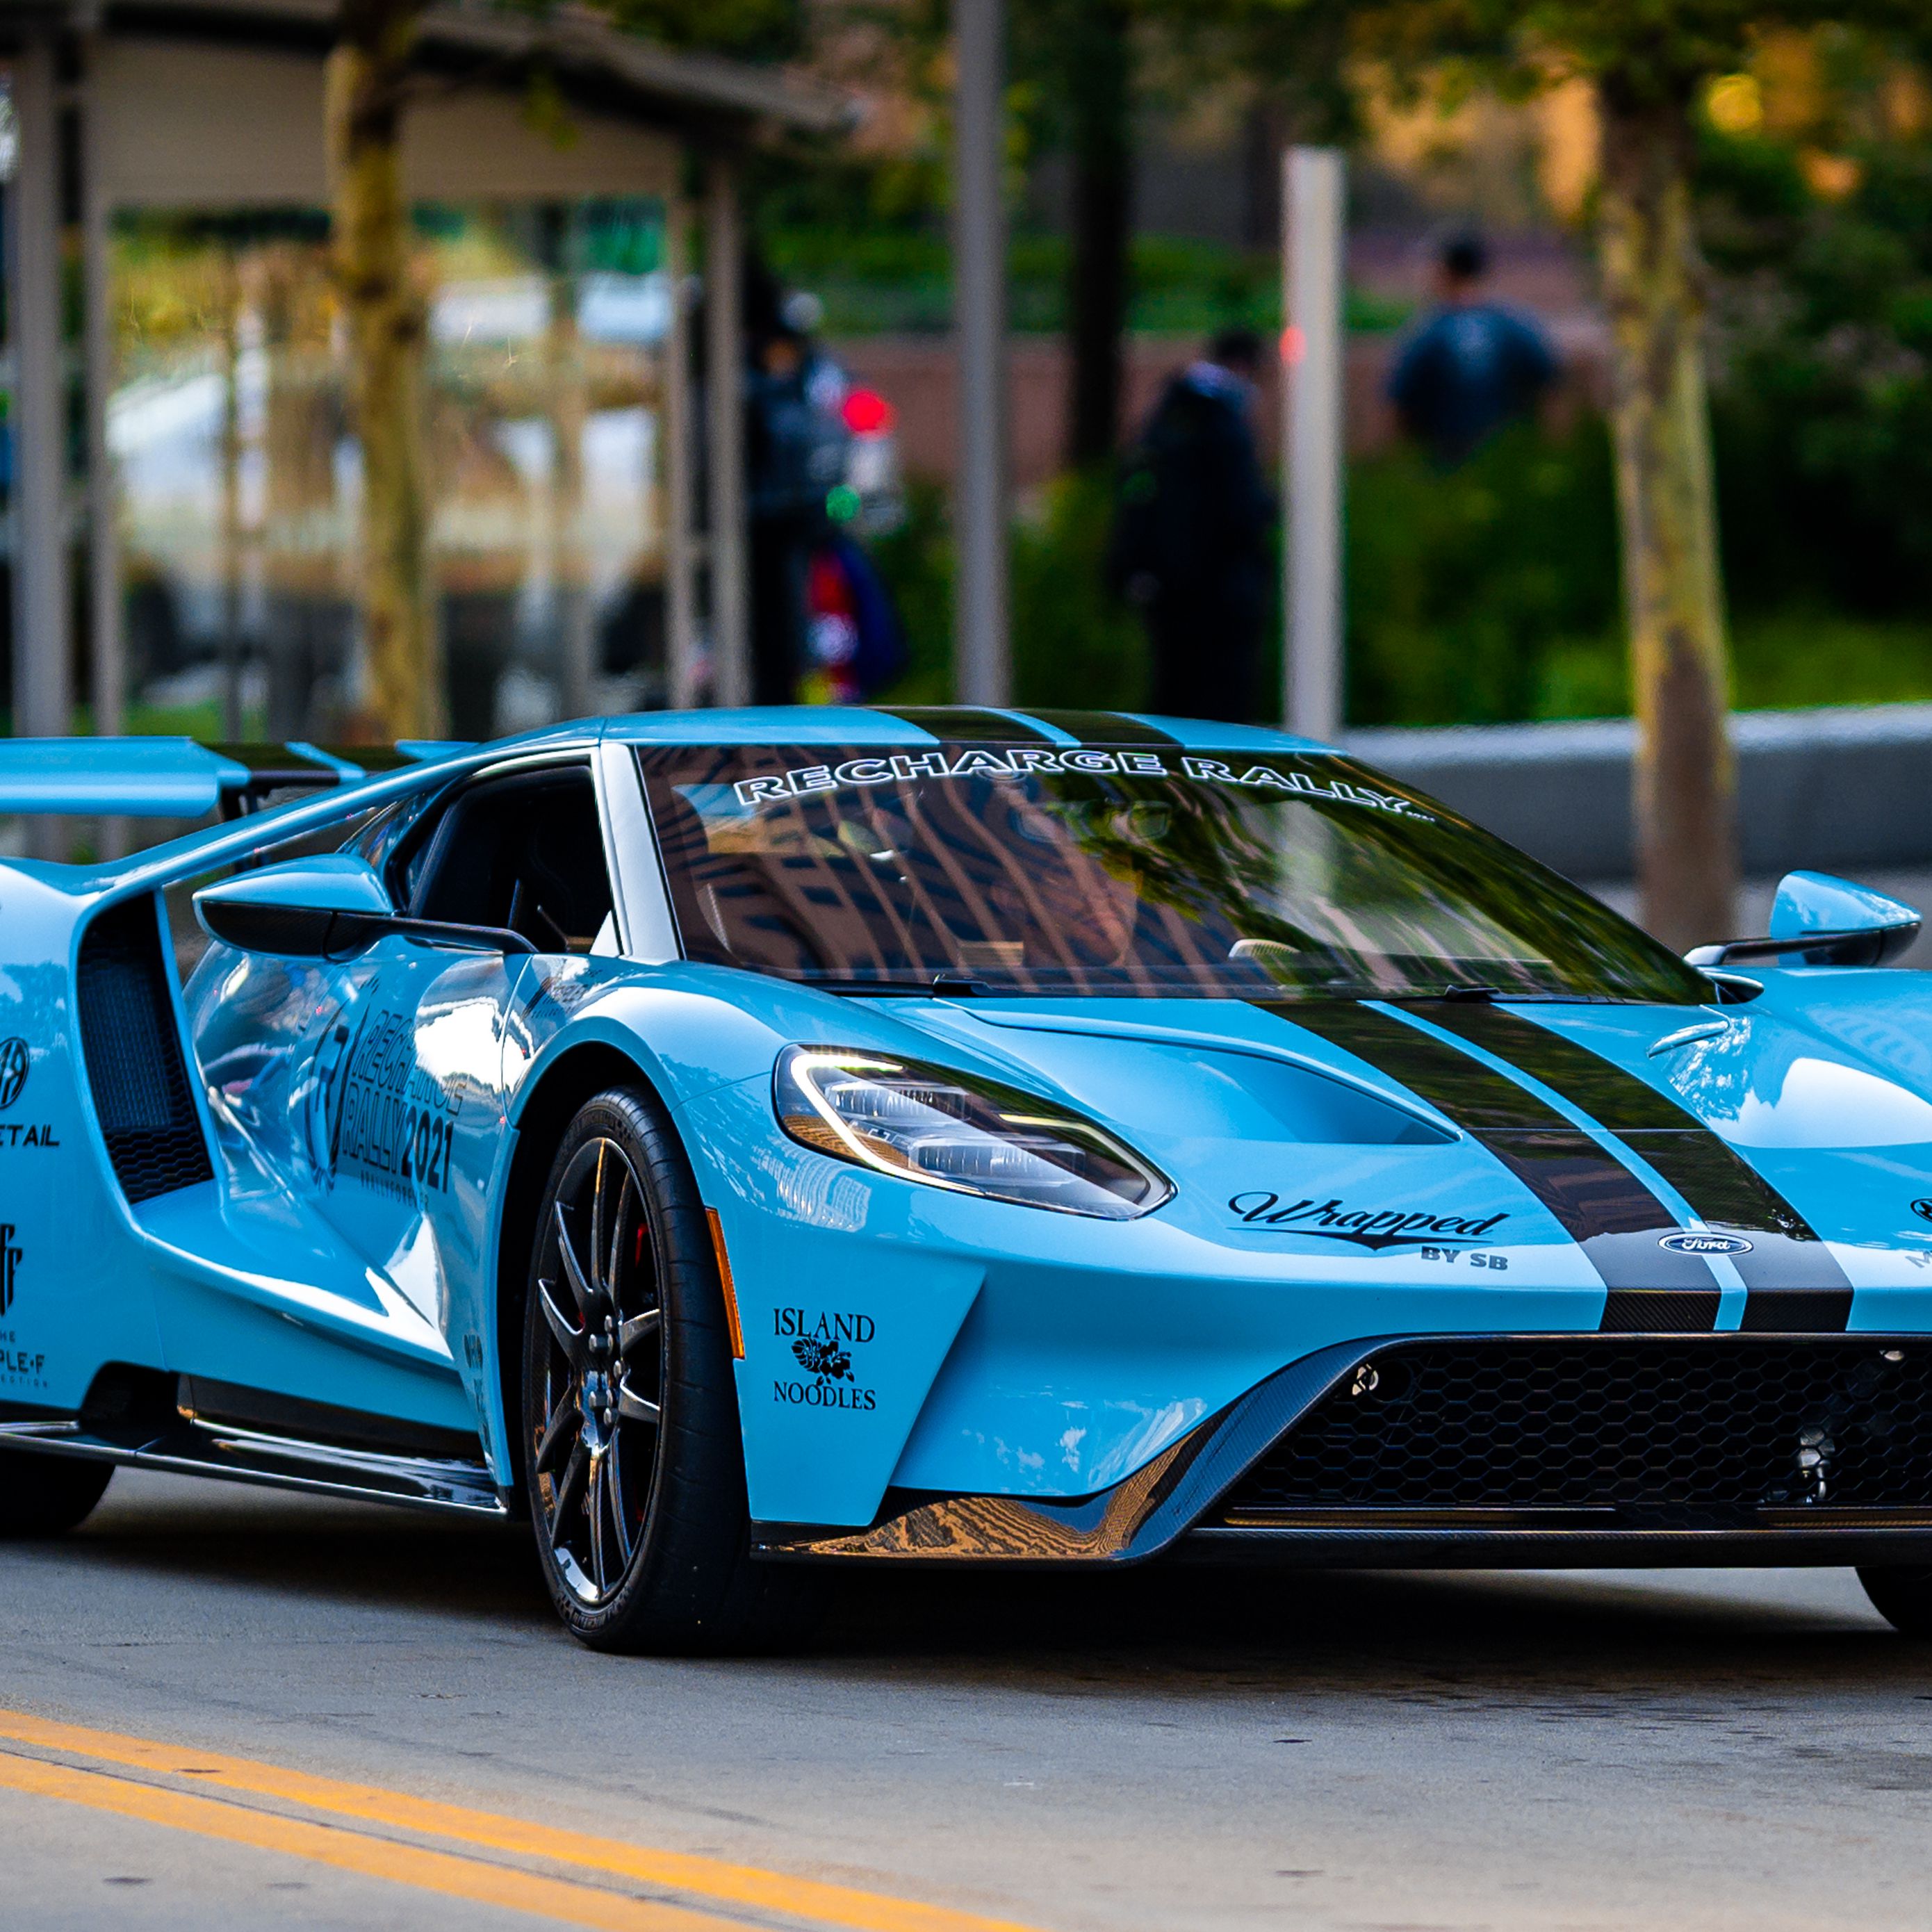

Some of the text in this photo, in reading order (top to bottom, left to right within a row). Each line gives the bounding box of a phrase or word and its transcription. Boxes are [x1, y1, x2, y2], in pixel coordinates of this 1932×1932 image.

[733, 749, 1410, 814] RECHARGE RALLY
[1228, 1191, 1510, 1236] Wrapped
[1421, 1245, 1509, 1271] BY SB
[1681, 1237, 1731, 1250] Ford
[773, 1307, 876, 1343] ISLAND
[773, 1380, 876, 1411] NOODLES
